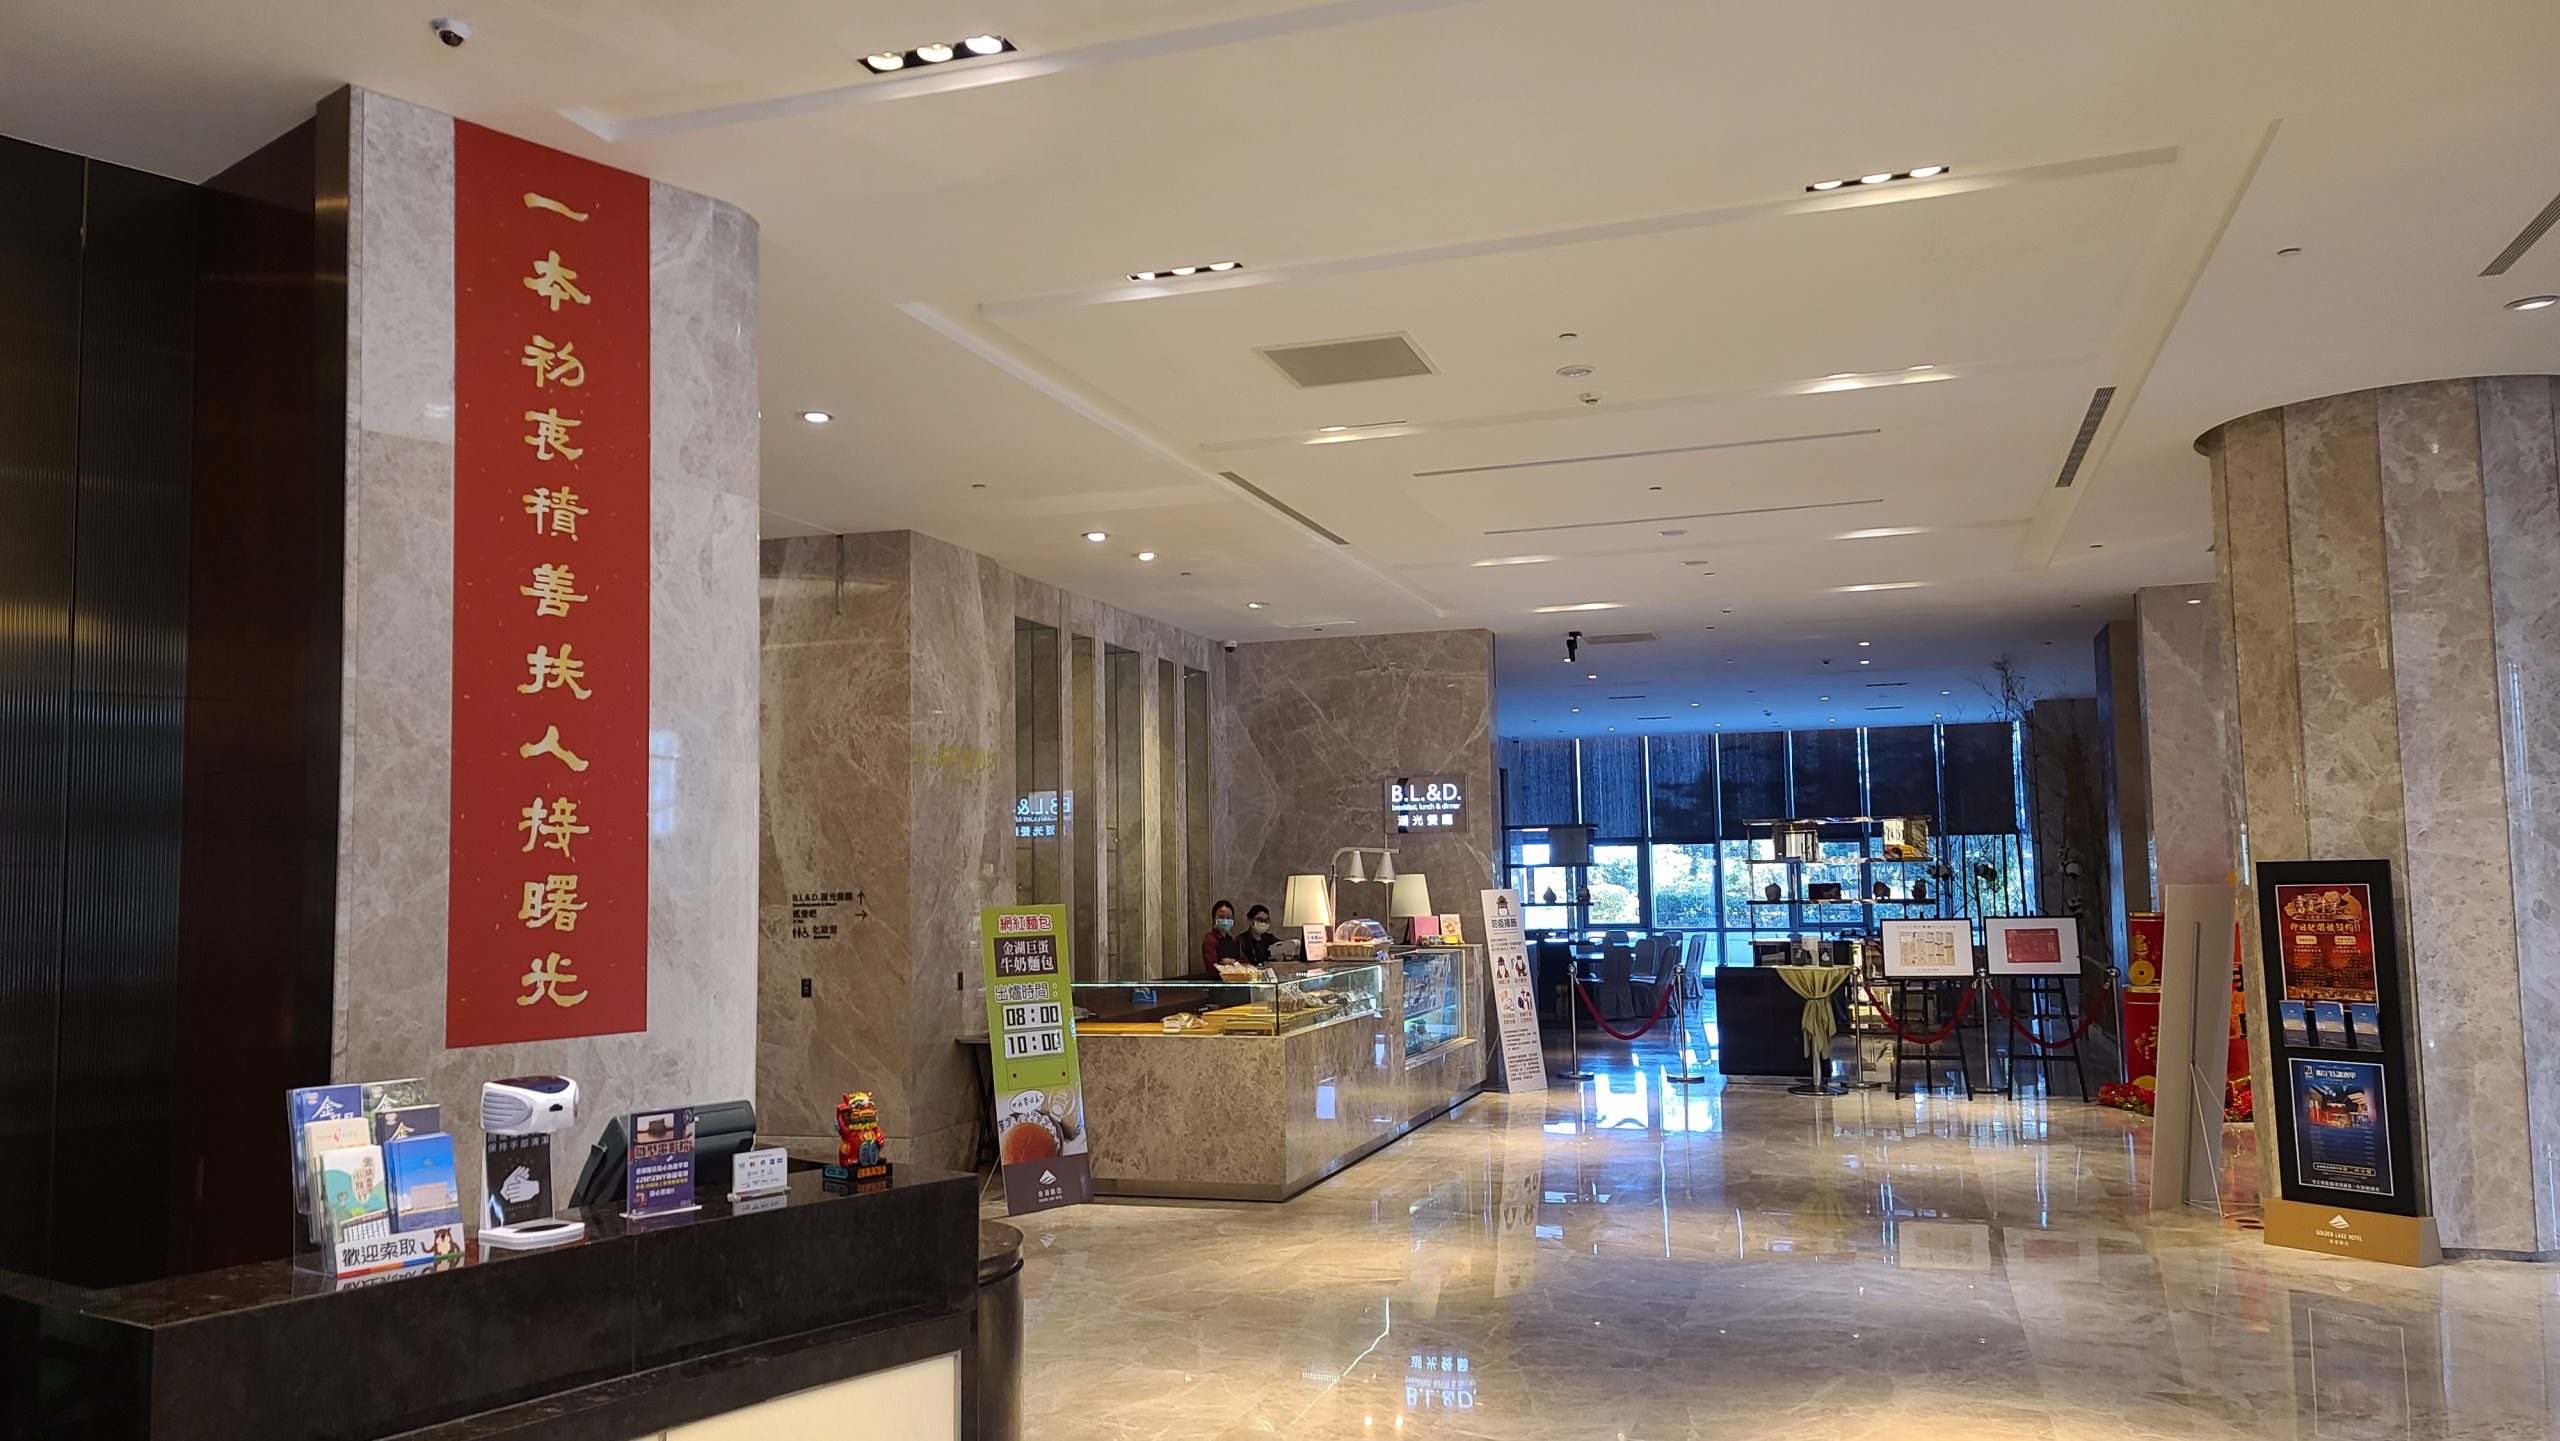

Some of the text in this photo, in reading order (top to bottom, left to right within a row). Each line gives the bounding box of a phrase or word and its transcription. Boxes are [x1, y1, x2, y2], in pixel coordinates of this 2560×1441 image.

[517, 191, 592, 1007] 一本初衷積善扶人接曙光
[1391, 783, 1462, 802] B.L.&D.
[999, 914, 1052, 932] 網紅麵包
[1003, 940, 1049, 956] 金湖巨蛋
[1001, 955, 1054, 974] 牛奶麵包
[1006, 1006, 1059, 1026] 08:00
[1008, 1032, 1062, 1055] 10:00
[2335, 1232, 2347, 1240] LAKE
[342, 1238, 418, 1267] 歡迎索取
